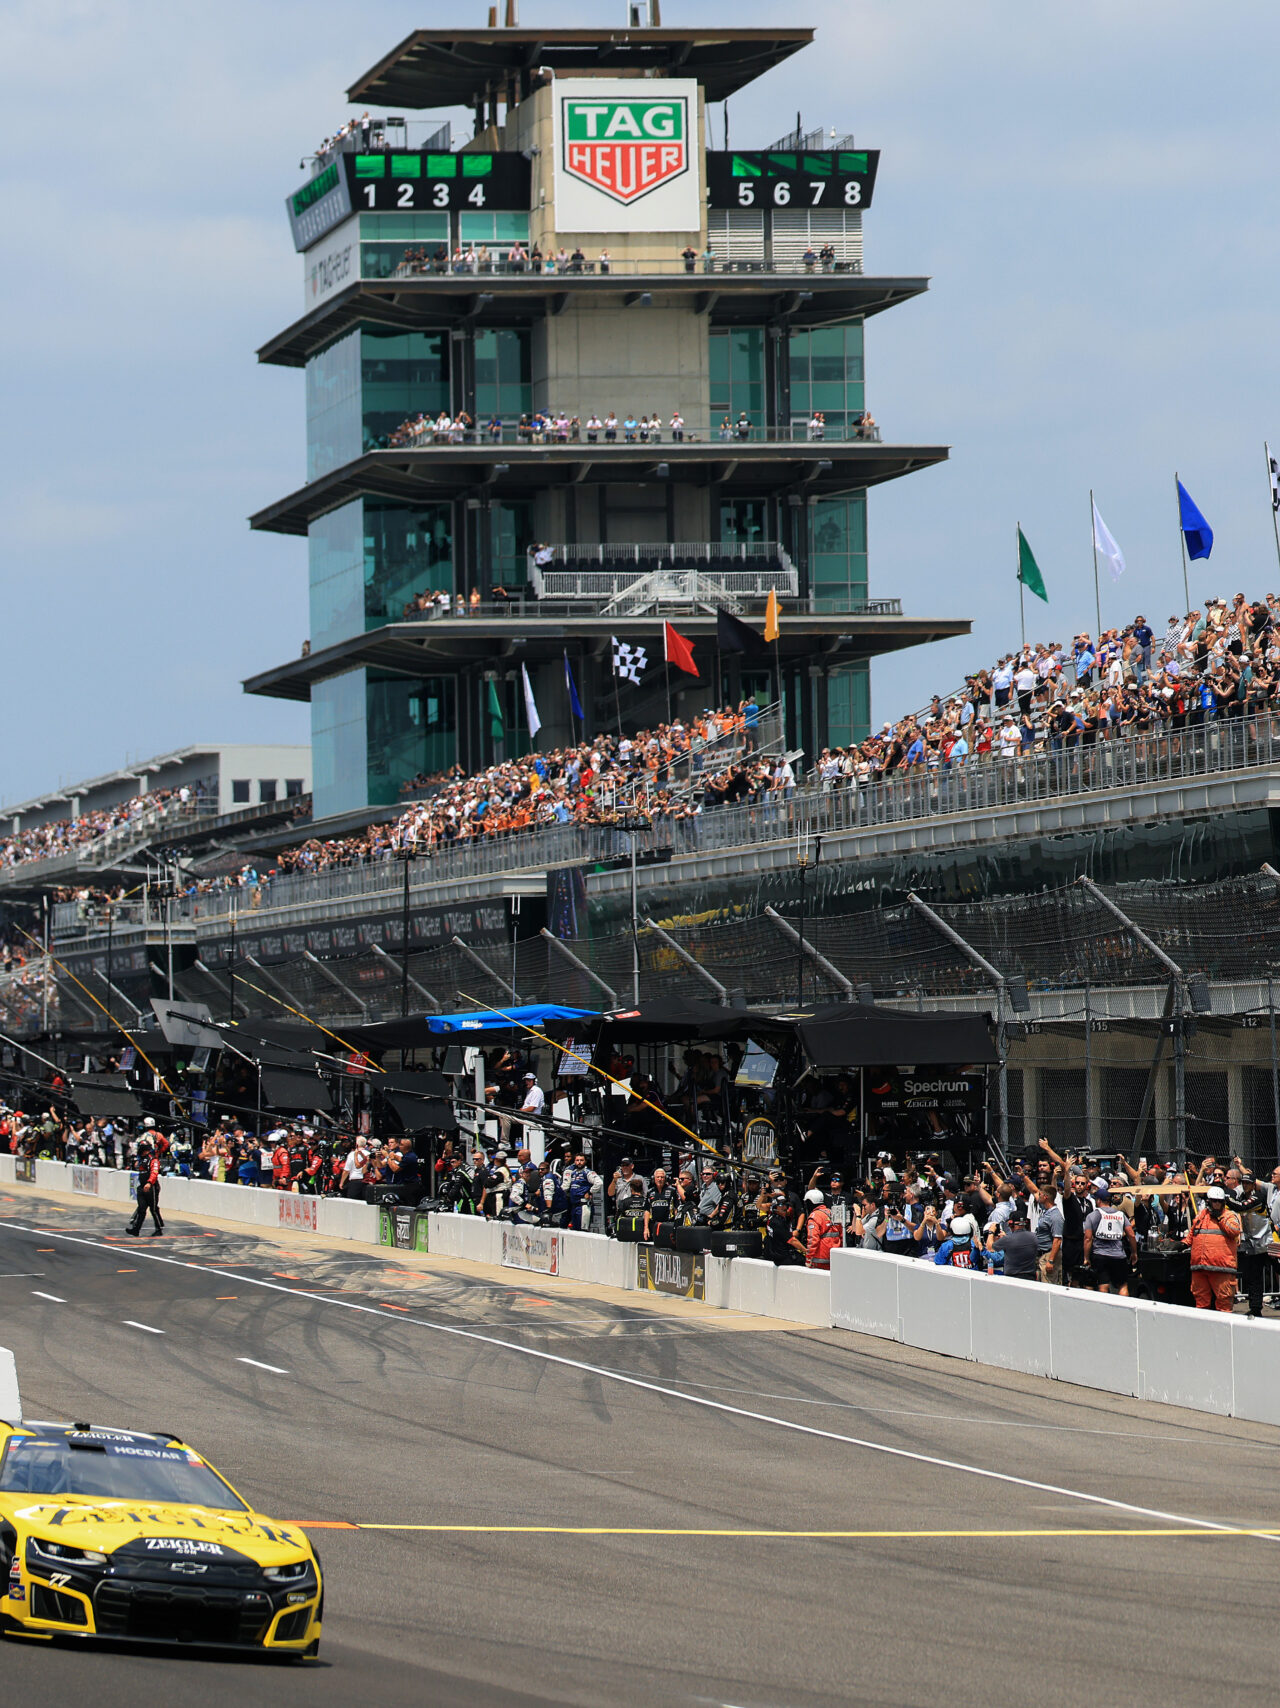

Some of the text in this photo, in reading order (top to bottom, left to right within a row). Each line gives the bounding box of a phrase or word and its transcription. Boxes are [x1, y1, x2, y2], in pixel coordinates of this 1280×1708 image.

[574, 106, 674, 137] TAG
[573, 147, 679, 195] HEUER
[363, 183, 486, 208] 1 2 3 4
[738, 182, 755, 206] 5
[773, 182, 791, 206] 6
[809, 182, 826, 205] 7
[844, 181, 861, 205] 8
[904, 1080, 969, 1096] Spectrum
[1107, 1221, 1113, 1232] 8
[70, 1430, 135, 1443] ZEIGLER
[114, 1445, 182, 1461] HOCEVAR
[144, 1538, 225, 1556] ZEIGLER
[48, 1572, 73, 1588] 77
